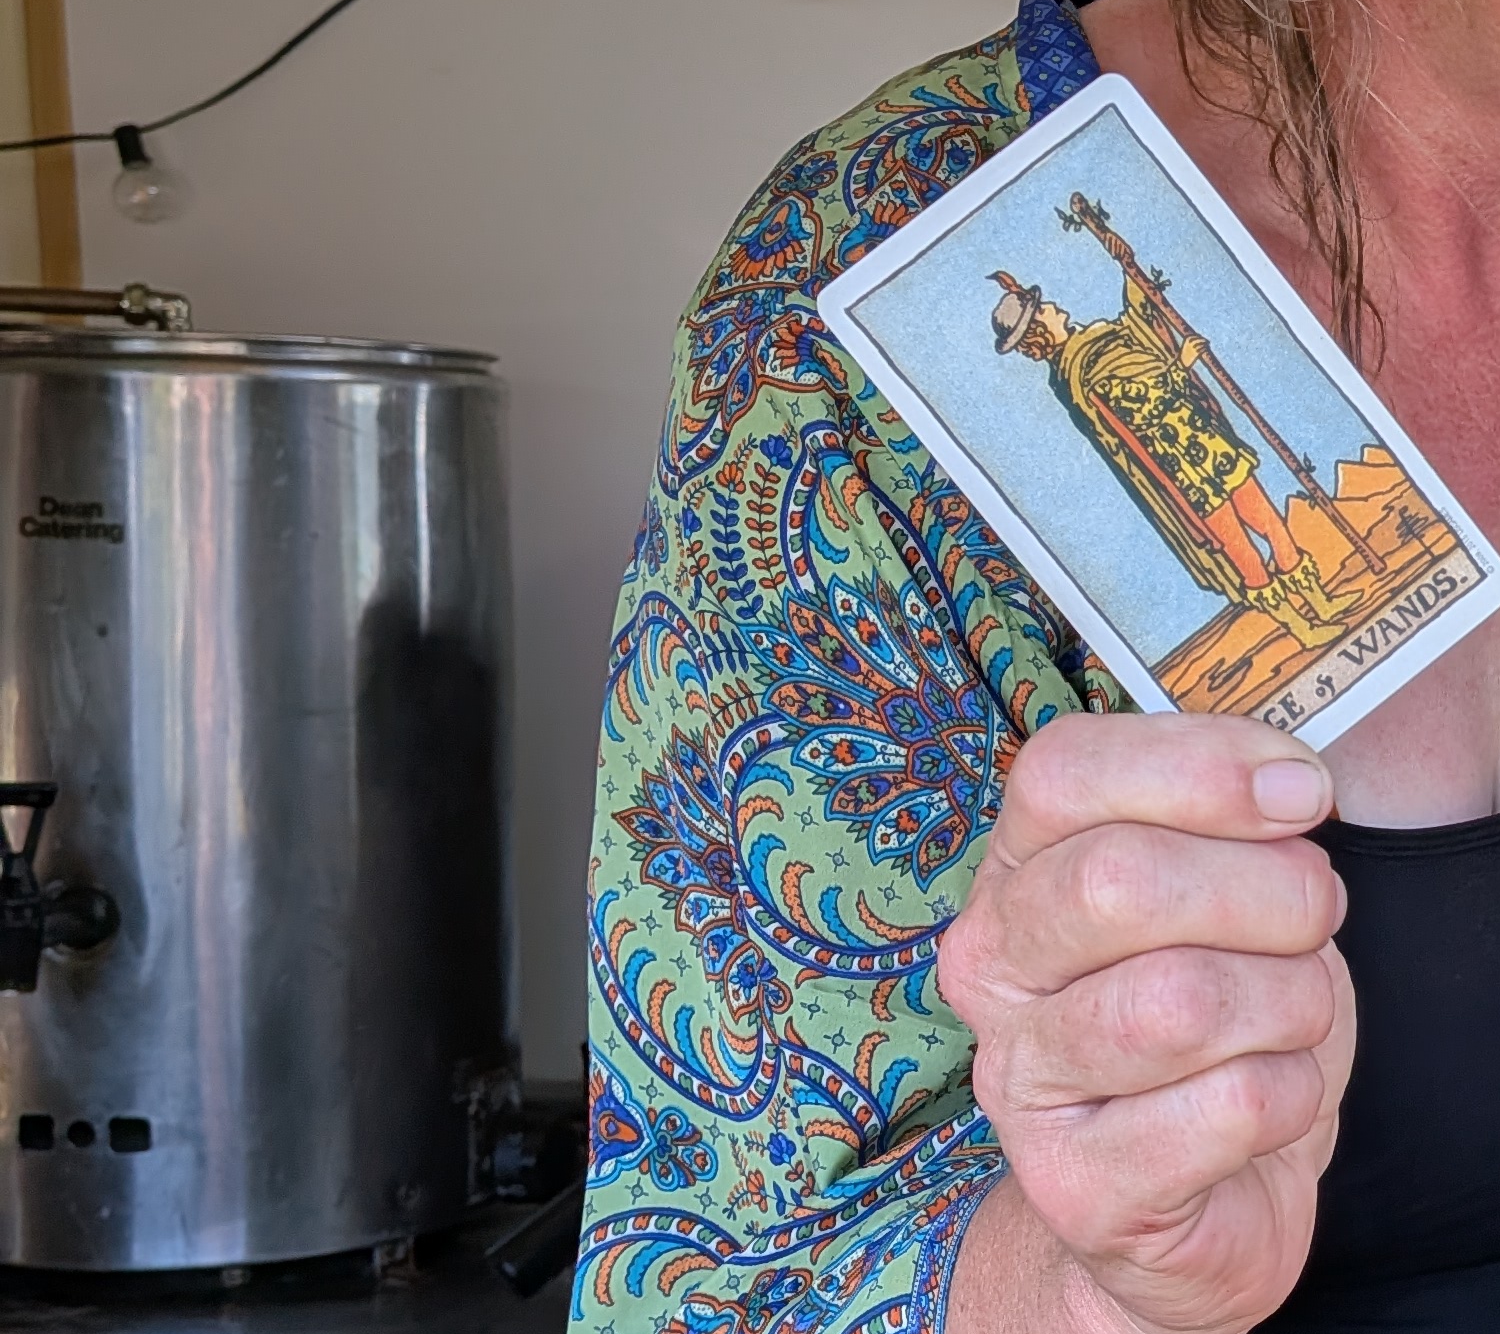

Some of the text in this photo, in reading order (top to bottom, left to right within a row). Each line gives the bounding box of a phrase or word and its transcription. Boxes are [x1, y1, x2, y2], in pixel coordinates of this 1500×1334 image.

[19, 516, 125, 545] Catering
[1263, 691, 1305, 731] GE
[1337, 568, 1468, 666] WANDS.
